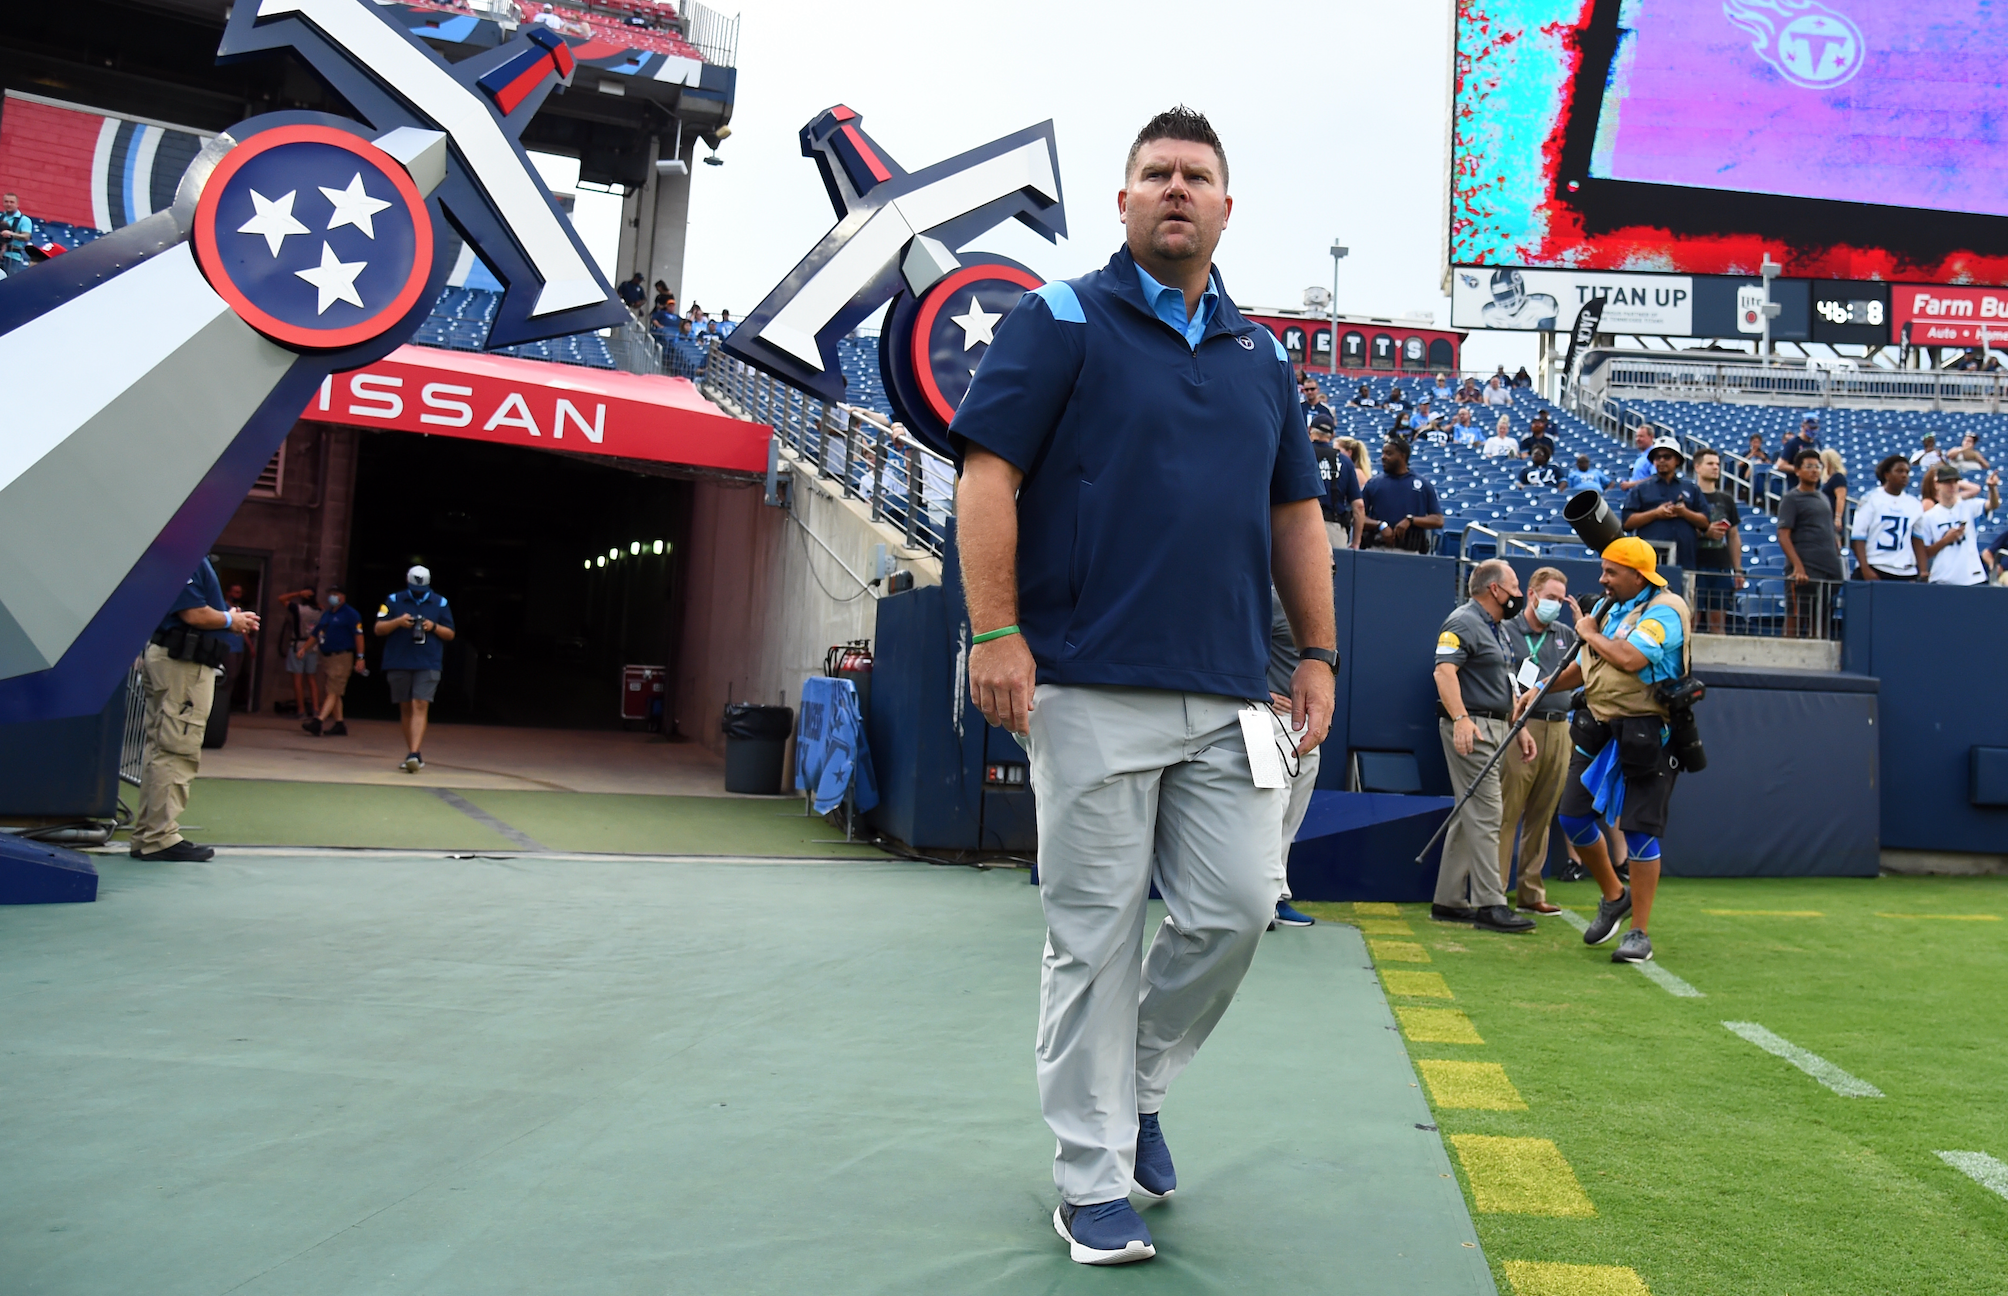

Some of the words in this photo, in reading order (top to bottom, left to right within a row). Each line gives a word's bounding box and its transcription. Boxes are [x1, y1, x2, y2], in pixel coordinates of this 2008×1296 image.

[1575, 285, 1646, 307] TITAN
[1655, 288, 1687, 308] UP
[1912, 293, 1974, 317] Farm
[1926, 326, 1958, 340] Auto
[1876, 515, 1909, 551] 31
